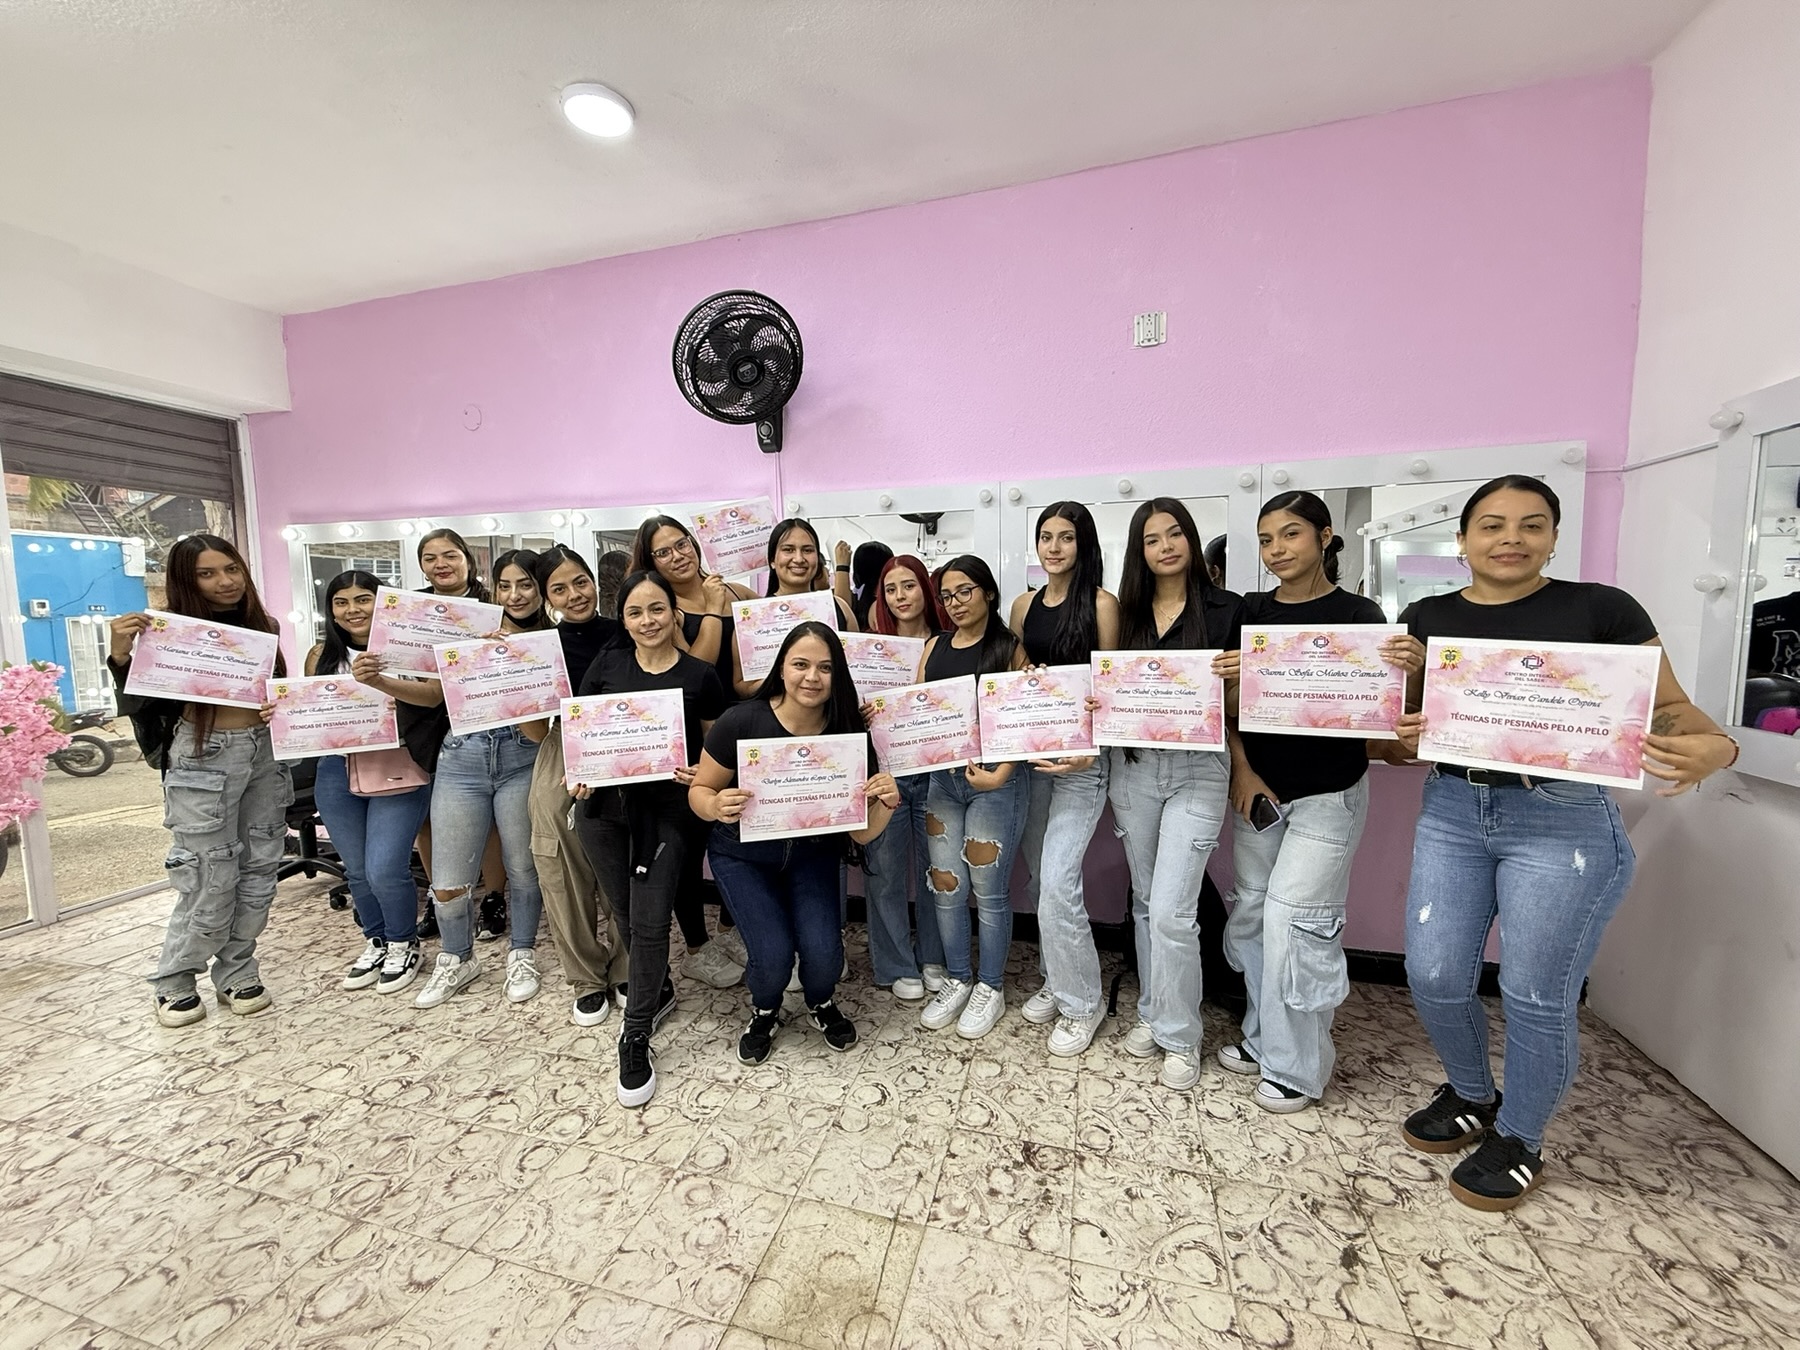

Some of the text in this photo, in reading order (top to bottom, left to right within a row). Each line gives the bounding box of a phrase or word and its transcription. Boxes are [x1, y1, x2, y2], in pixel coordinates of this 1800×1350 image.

[389, 639, 414, 647] TÉCNICAS
[155, 662, 183, 671] TÉCNICAS
[192, 668, 220, 677] PESTAÑAS
[1257, 668, 1286, 676] Danna
[1350, 669, 1388, 677] Camacho
[465, 691, 491, 700] TÉCNICAS
[499, 685, 523, 694] PESTAÑAS
[1303, 691, 1336, 700] PESTAÑAS
[1463, 688, 1491, 700] Kelly
[1493, 690, 1526, 702] Vivian
[1528, 694, 1565, 706] Candelo
[1568, 697, 1602, 708] Ospina
[1143, 707, 1168, 715] PESTAÑAS
[997, 721, 1018, 729] TÉCNICAS
[1026, 718, 1049, 726] PESTAÑAS
[1451, 711, 1489, 724] TÉCNICAS
[1491, 717, 1502, 726] DE
[1504, 718, 1549, 730] PESTAÑAS
[1551, 723, 1574, 734] PELO
[1576, 725, 1583, 734] A
[1585, 727, 1609, 736] PELO
[890, 740, 911, 748] TÉCNICAS
[919, 735, 940, 743] PESTAÑAS
[582, 748, 605, 757] TÉCNICAS
[614, 745, 638, 754] PESTAÑAS
[793, 794, 818, 803] PESTAÑAS
